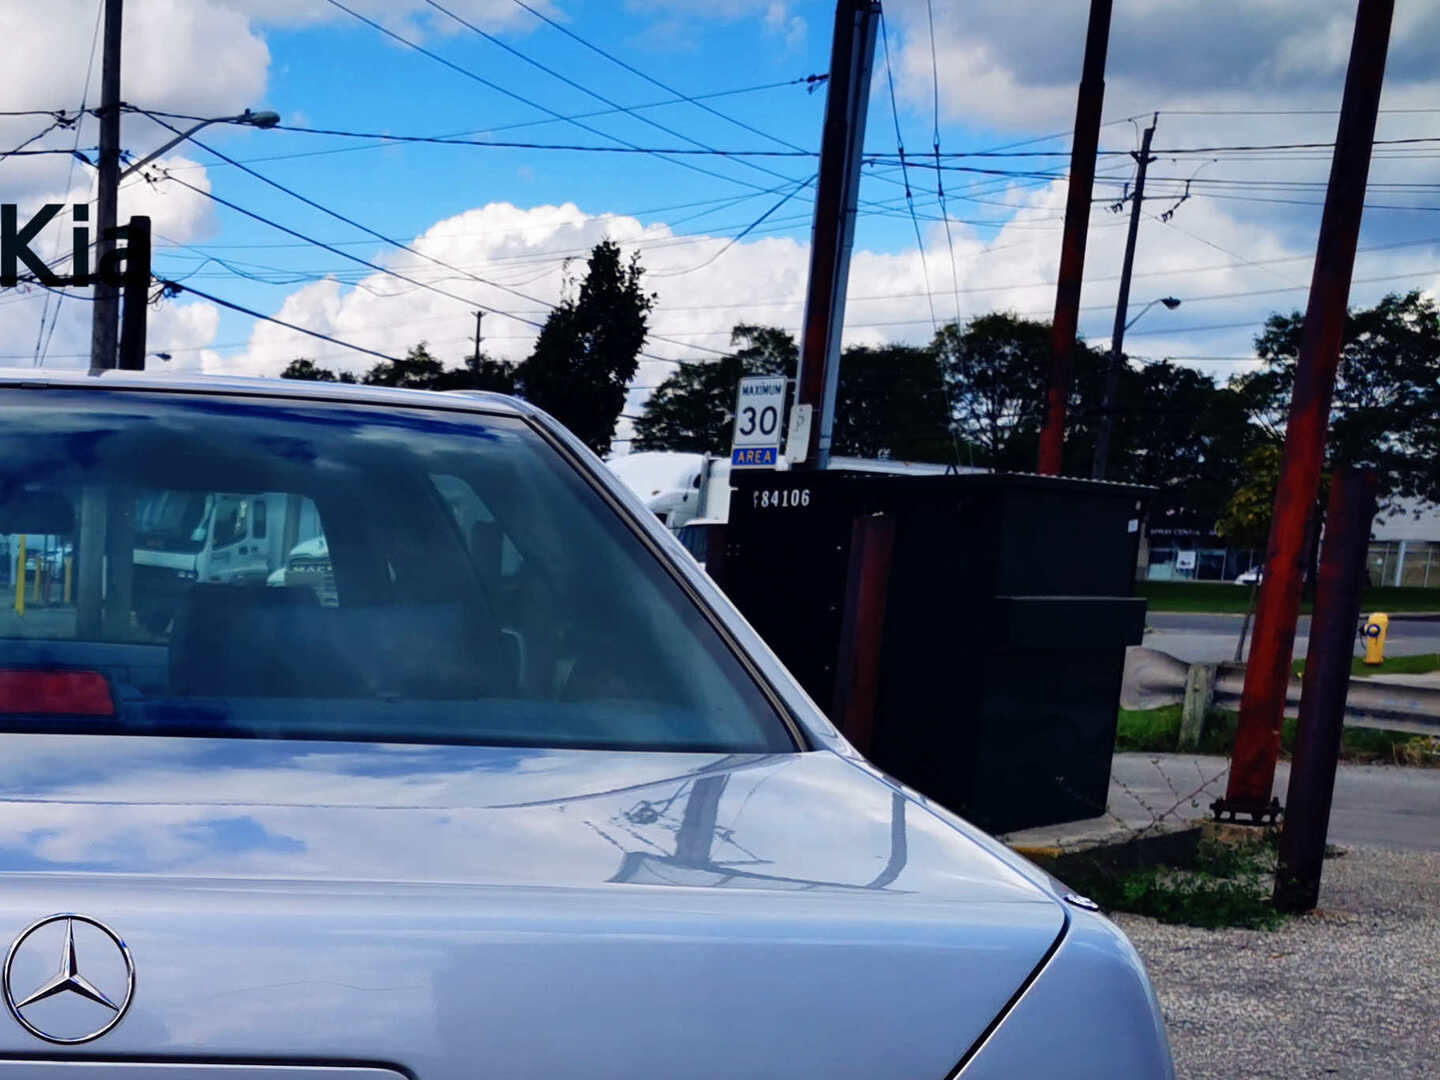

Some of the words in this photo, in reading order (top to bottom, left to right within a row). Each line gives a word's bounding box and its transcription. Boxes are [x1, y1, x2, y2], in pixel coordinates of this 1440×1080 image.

[742, 384, 781, 395] MAXIMUM
[739, 406, 777, 436] 30
[737, 450, 772, 463] AREA
